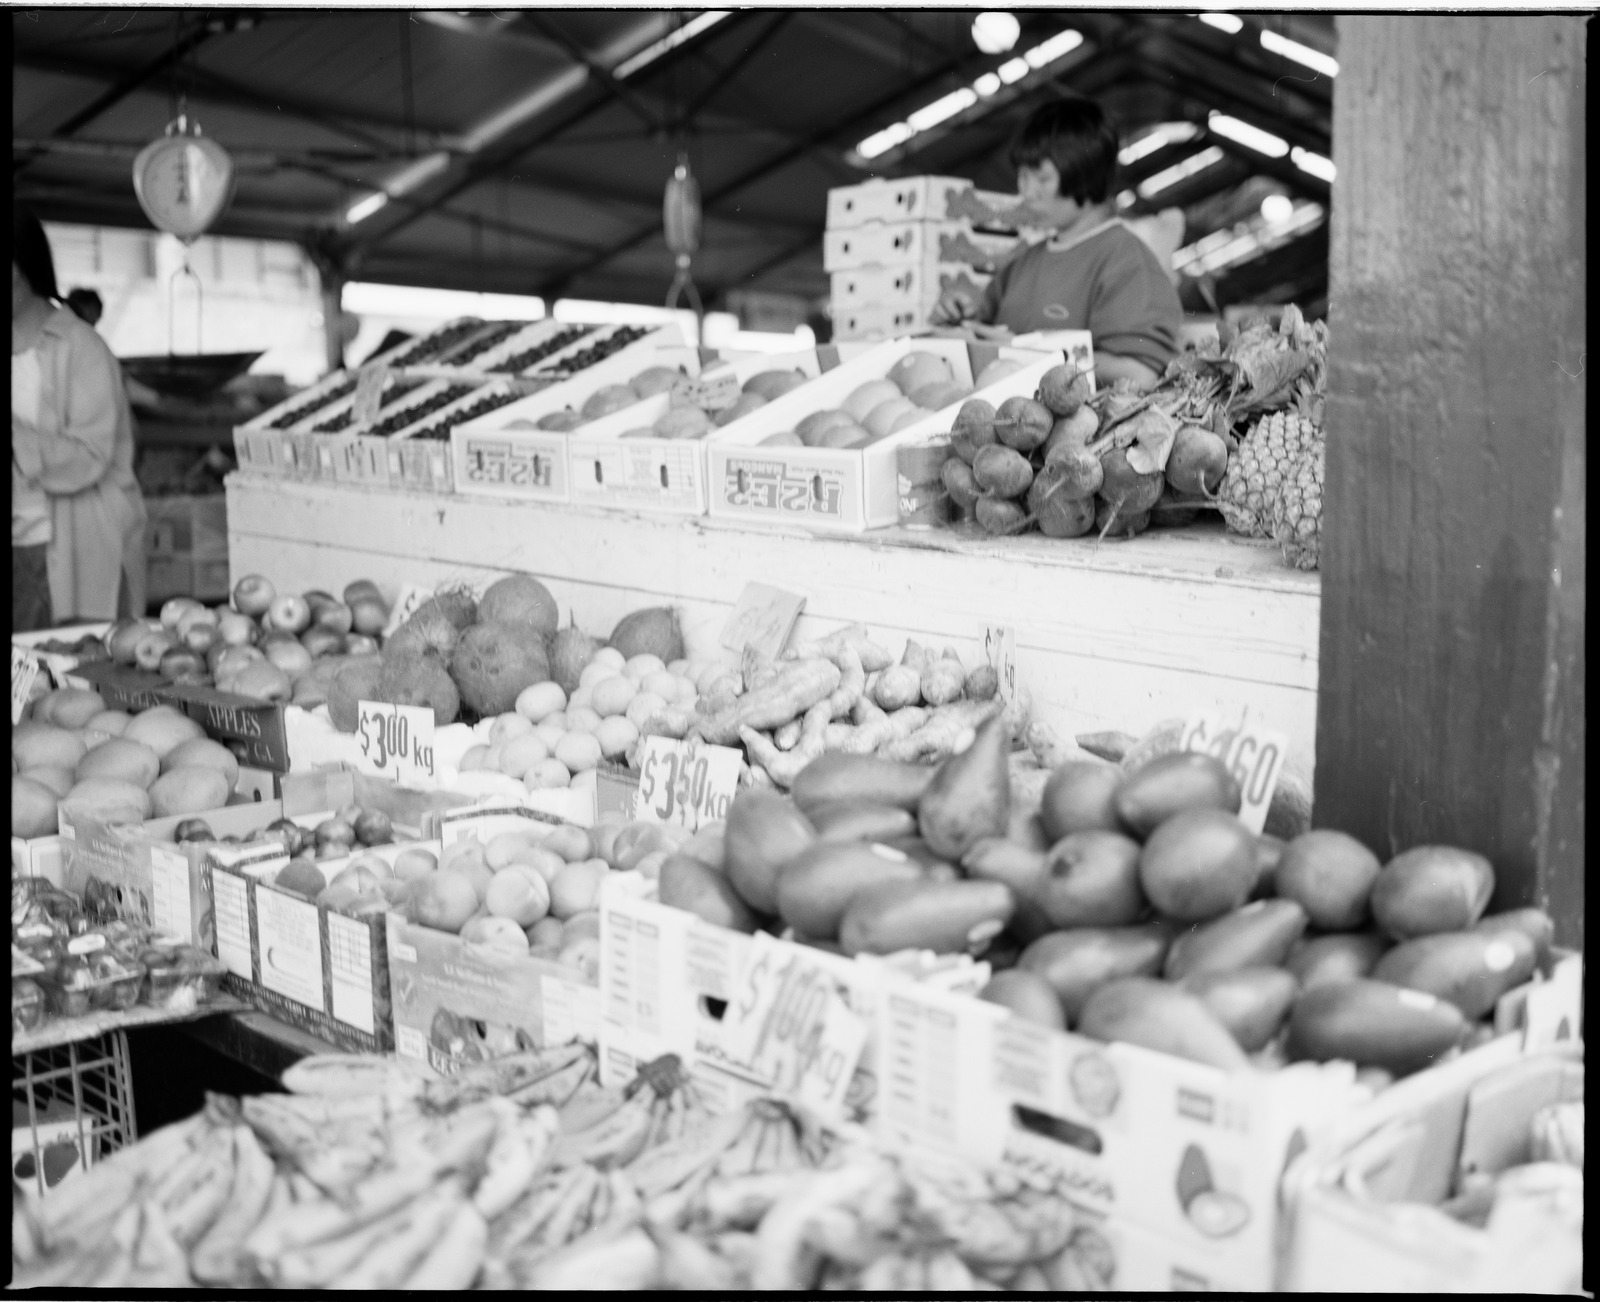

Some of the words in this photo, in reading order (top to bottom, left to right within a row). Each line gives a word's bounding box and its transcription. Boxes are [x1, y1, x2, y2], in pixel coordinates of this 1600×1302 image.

[724, 477, 842, 516] R2E2
[206, 704, 262, 739] APPLES
[413, 736, 435, 776] kg
